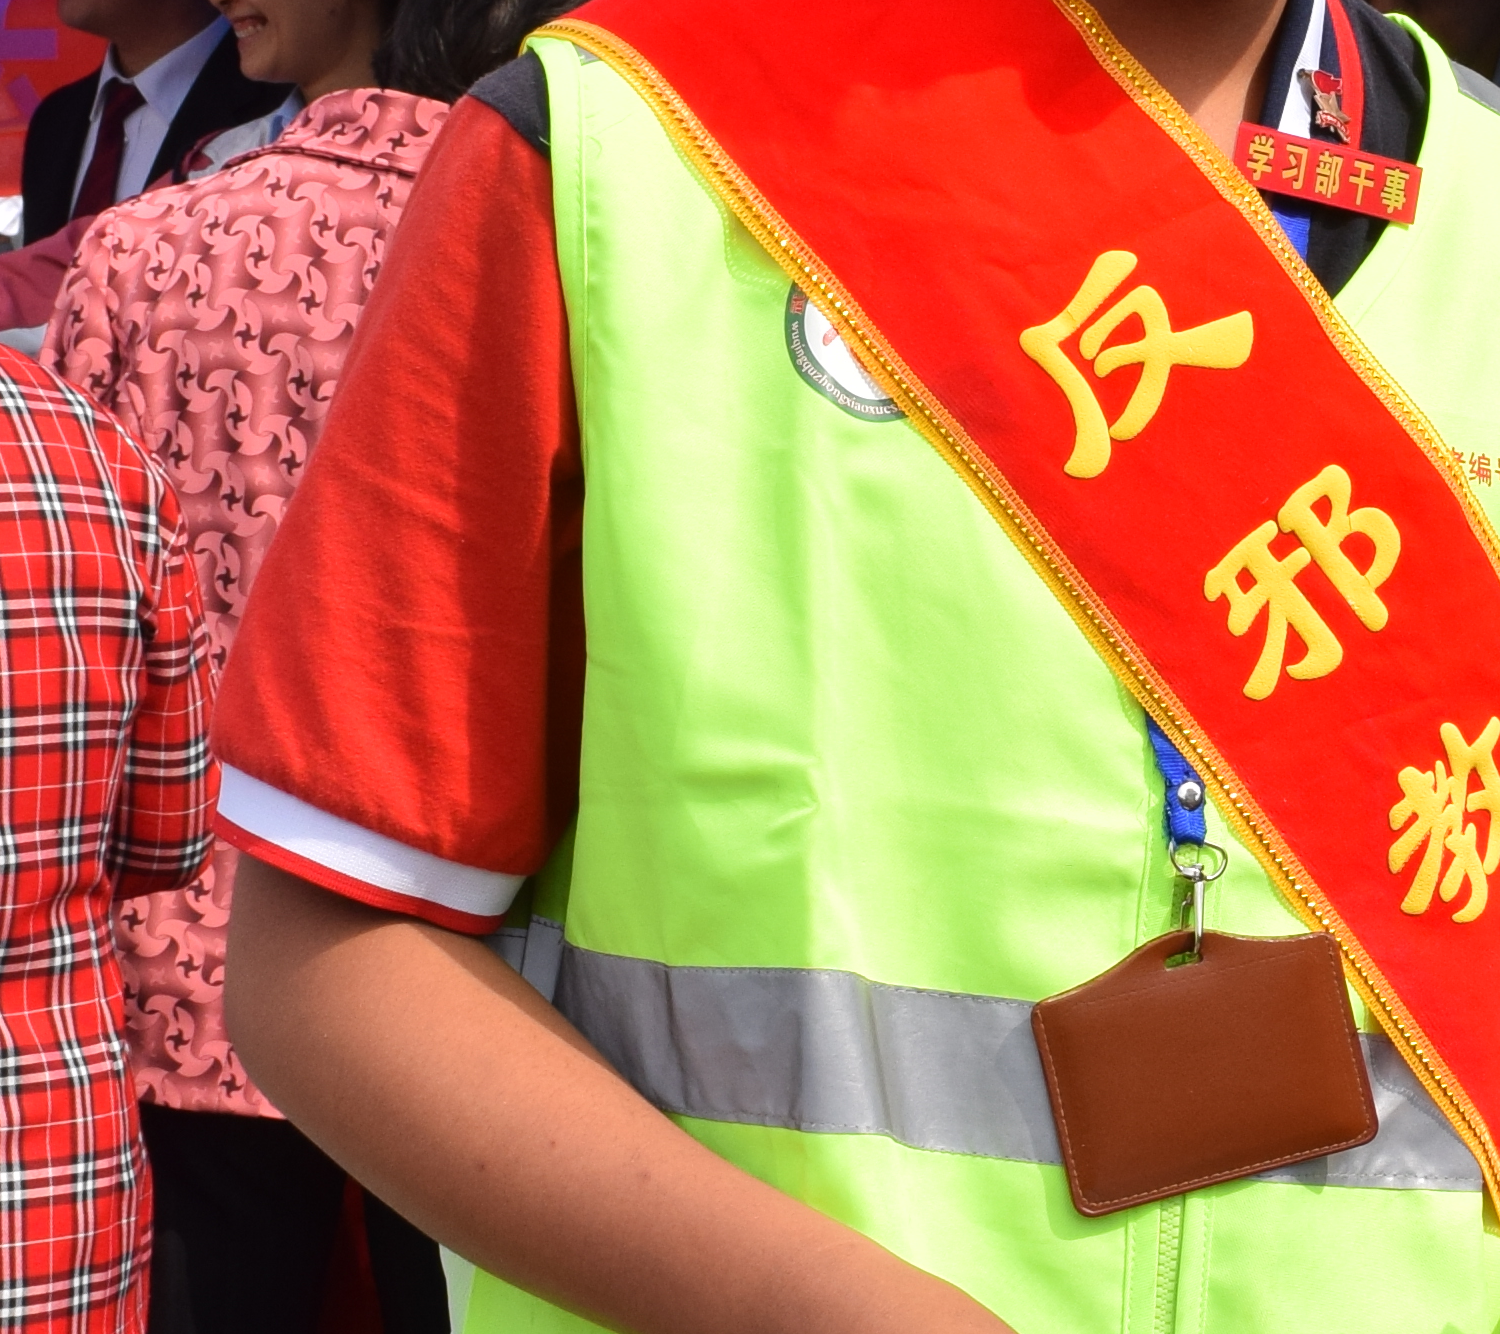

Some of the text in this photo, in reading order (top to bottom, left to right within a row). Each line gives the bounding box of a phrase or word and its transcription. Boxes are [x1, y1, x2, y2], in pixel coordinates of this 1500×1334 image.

[1246, 133, 1410, 214] 学习部干事
